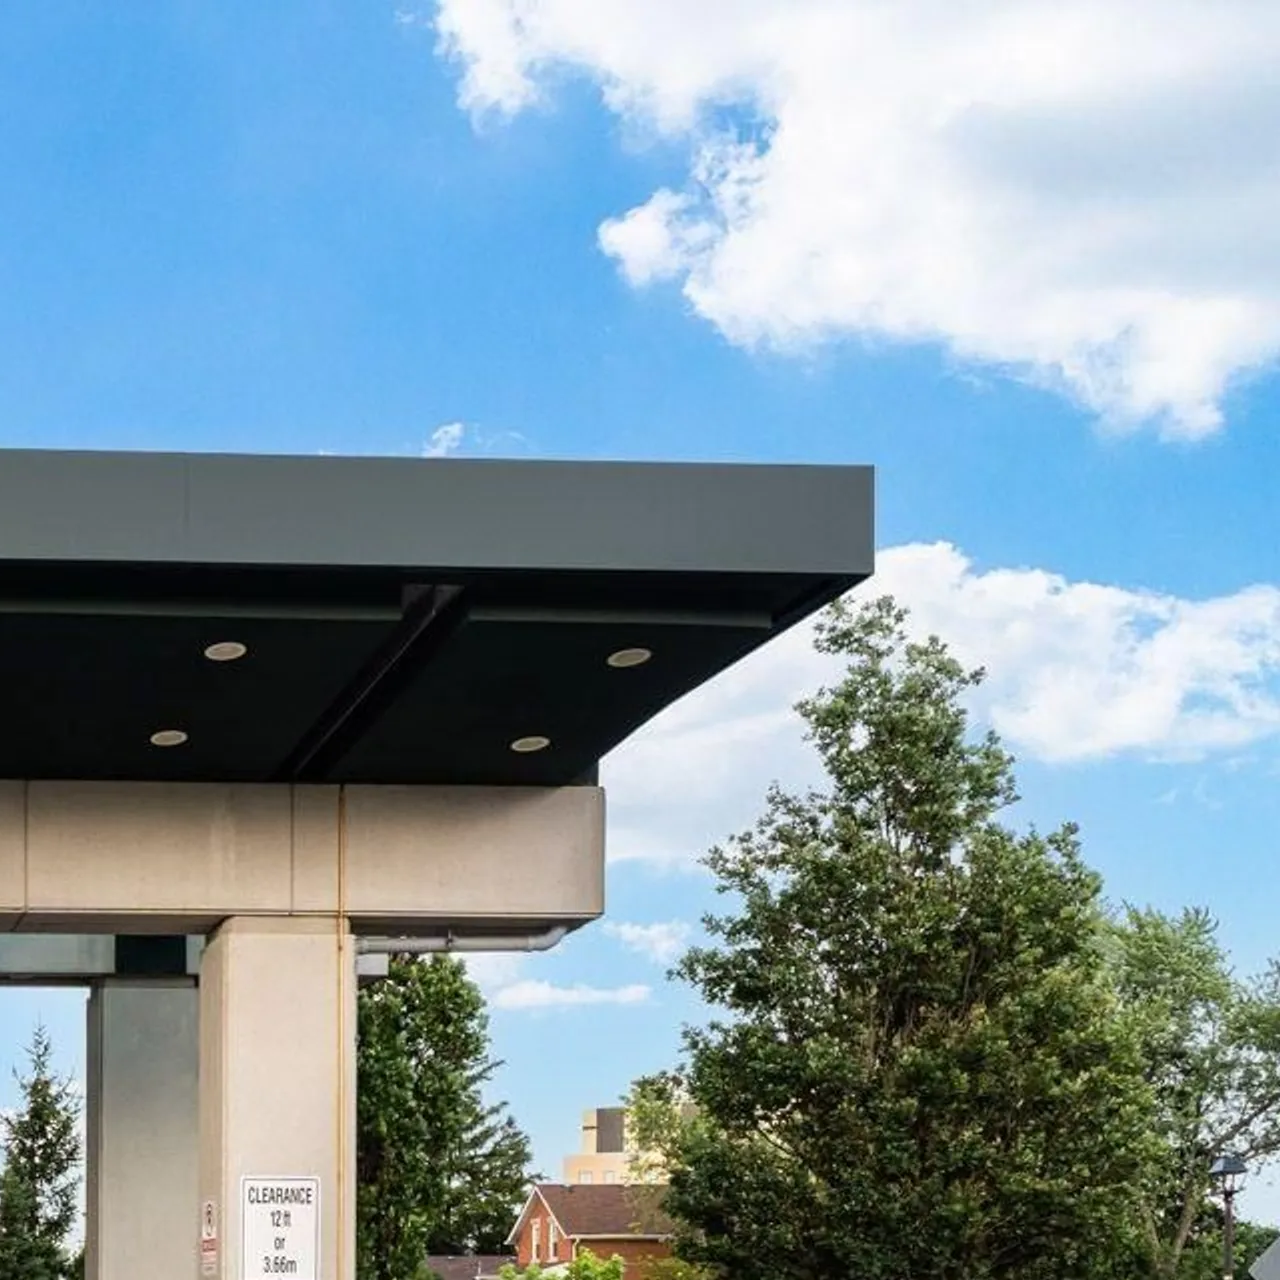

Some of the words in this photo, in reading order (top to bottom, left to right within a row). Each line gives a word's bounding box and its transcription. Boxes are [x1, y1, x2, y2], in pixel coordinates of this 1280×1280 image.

[248, 1186, 312, 1205] CLEARANCE
[274, 1237, 285, 1250] or
[263, 1255, 297, 1274] 3.66m
